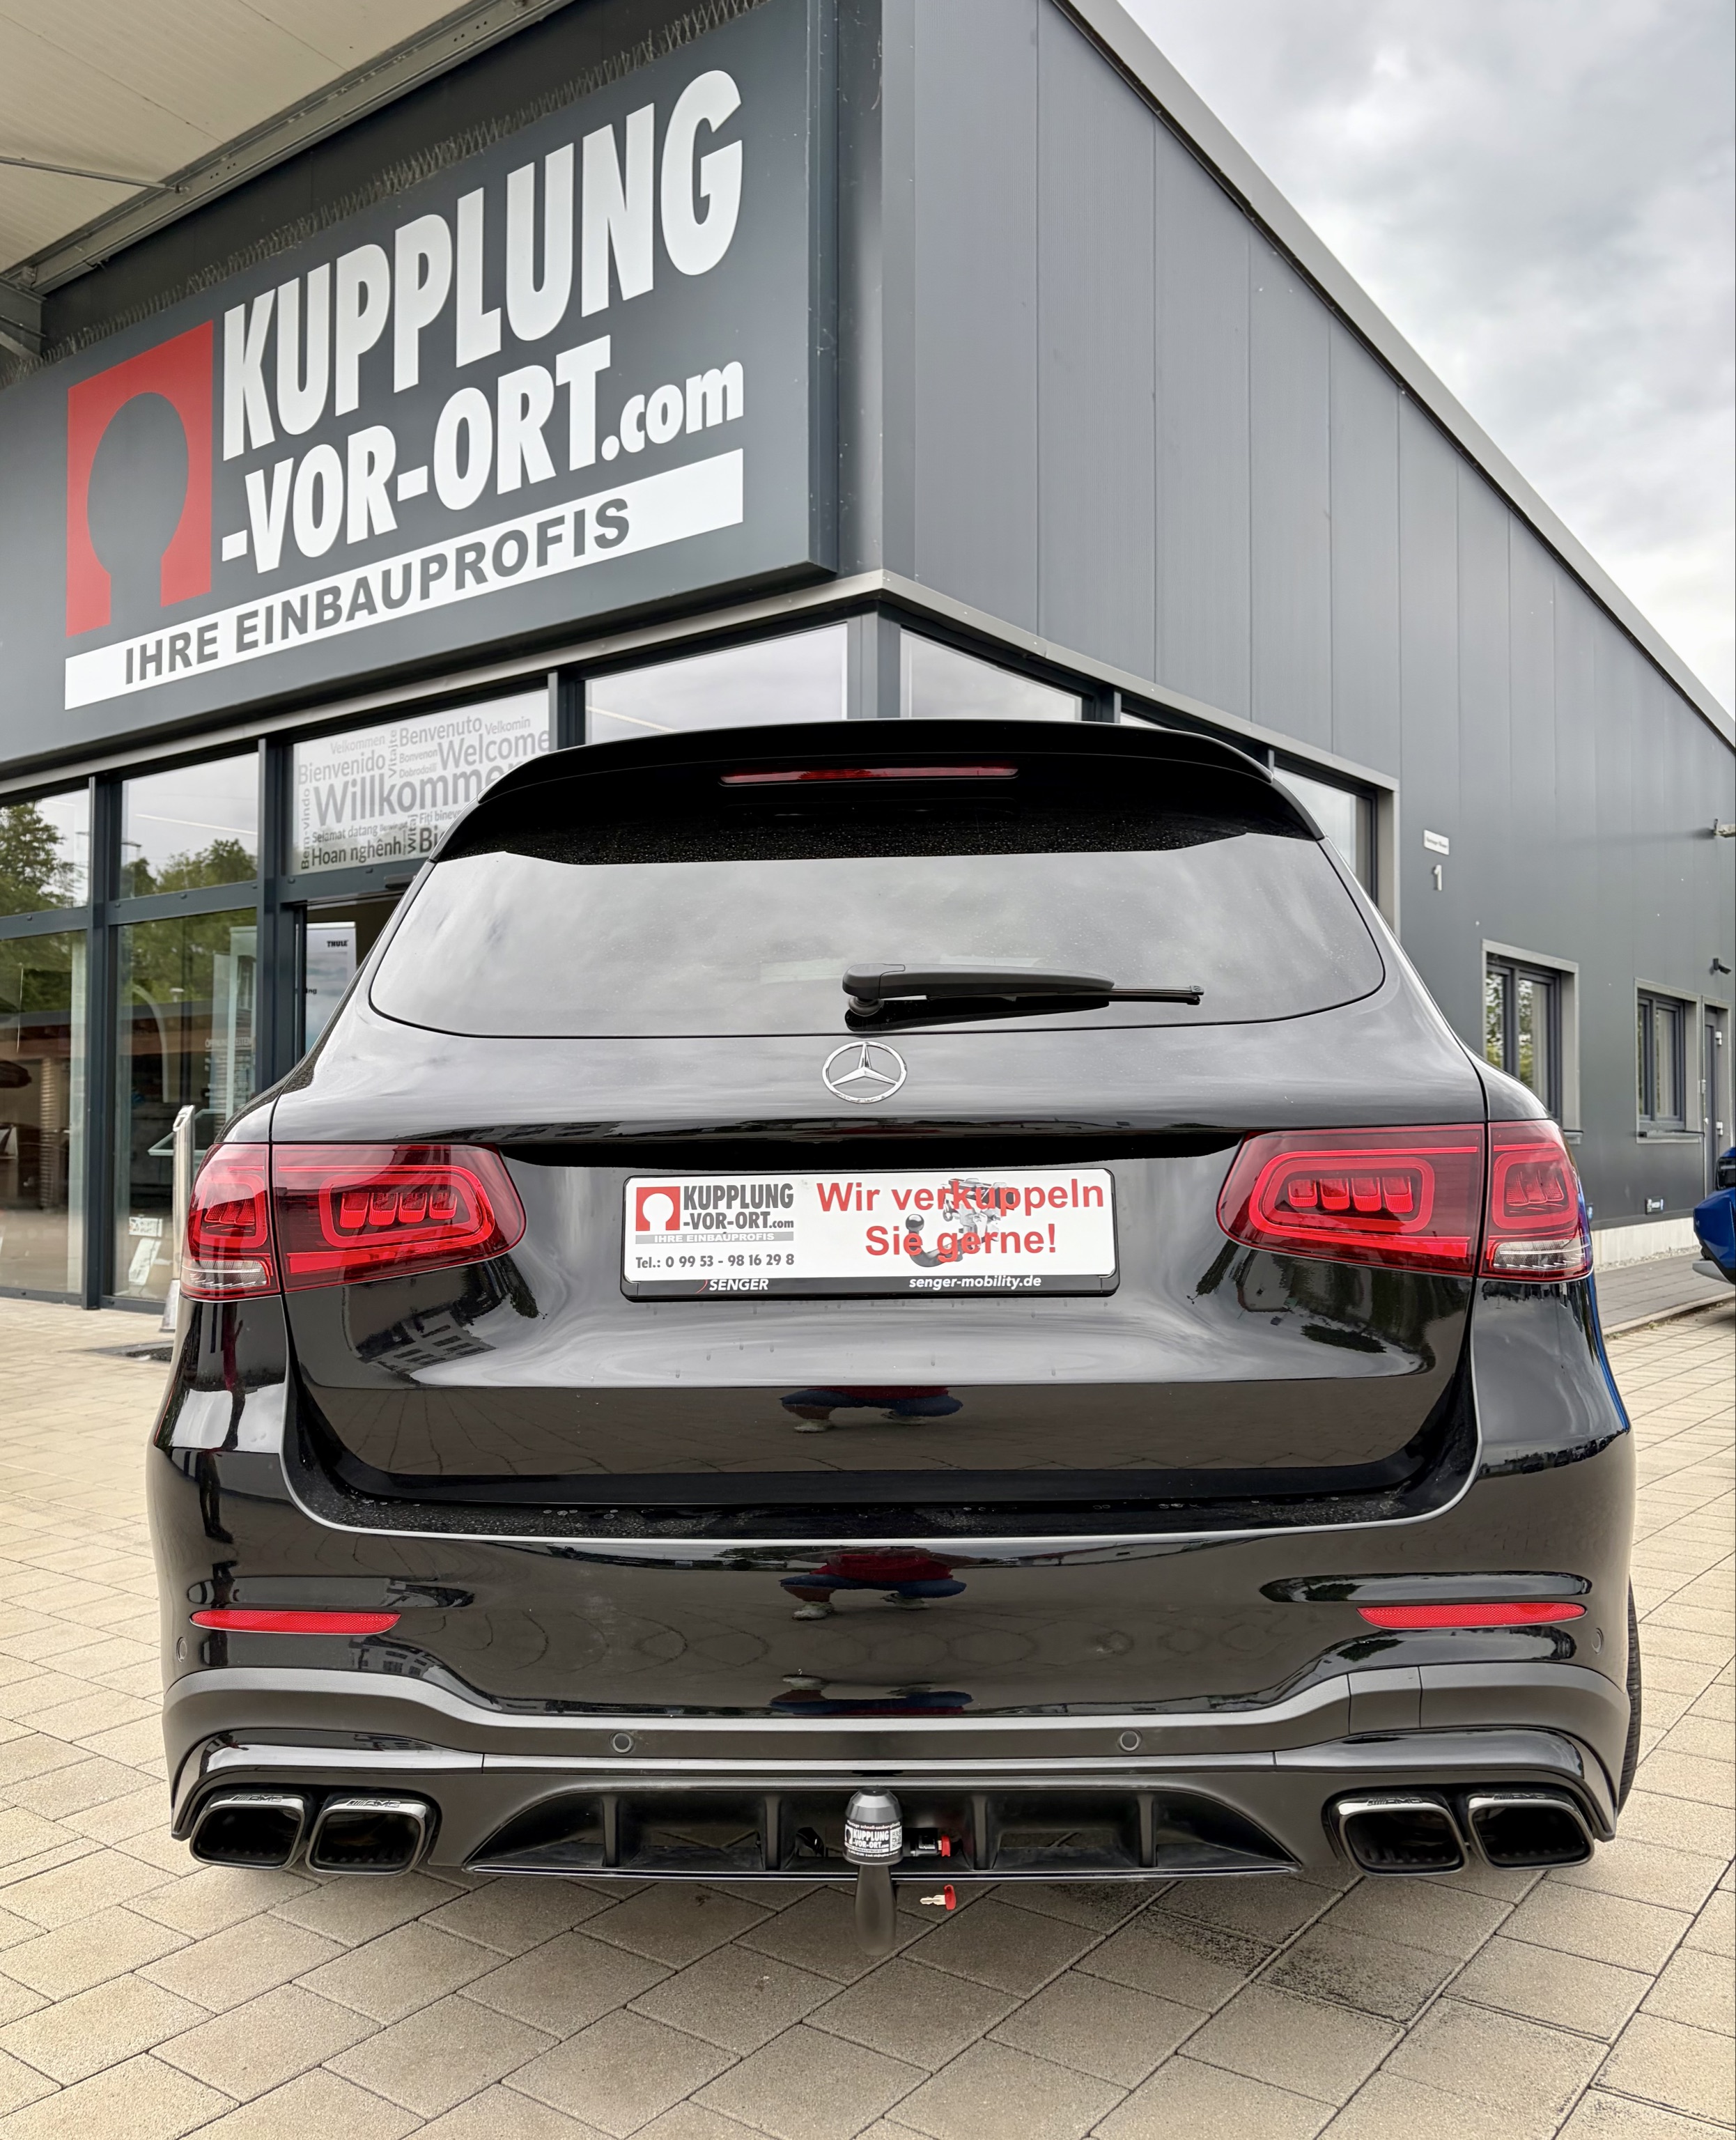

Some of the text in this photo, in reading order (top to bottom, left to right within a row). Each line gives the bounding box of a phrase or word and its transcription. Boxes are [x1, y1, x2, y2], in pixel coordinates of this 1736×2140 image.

[222, 70, 743, 461] KUPPLUNG
[222, 334, 743, 575] -VOR-ORT.com
[125, 497, 630, 685] IHRE EINBAUPROFIS
[330, 736, 385, 754] Velkommen
[400, 716, 531, 747] Benvenuto Velkomin
[388, 729, 398, 779] Vitajte
[400, 749, 437, 763] Bonvenon
[437, 730, 549, 770] Welcome
[299, 750, 385, 785] Bienvenido
[313, 761, 523, 827] Willkomme
[301, 789, 310, 869] Bem-vindo
[312, 829, 346, 843] Selamat
[348, 825, 378, 837] datang
[408, 814, 418, 854] Witaj
[312, 847, 346, 866] Hoan
[350, 836, 401, 863] nghênh
[1434, 864, 1442, 891] 1
[683, 1184, 794, 1210] KUPPLUNG
[816, 1179, 1103, 1216] Wir verkuppeln
[683, 1211, 794, 1230] -VOR-ORT.com
[686, 1233, 775, 1242] EINBAUPROFIS
[865, 1223, 1056, 1262] Sie gerne!
[636, 1257, 660, 1268] Tel.:
[665, 1256, 674, 1268] 0
[679, 1255, 696, 1267] 99
[699, 1255, 713, 1267] 53
[728, 1255, 745, 1266] 98
[749, 1254, 761, 1266] 16
[766, 1254, 782, 1266] 29
[786, 1253, 794, 1265] 8
[709, 1275, 1042, 1291] SENGER senger-mobility.de
[853, 1829, 889, 1841] KUPPLUNG
